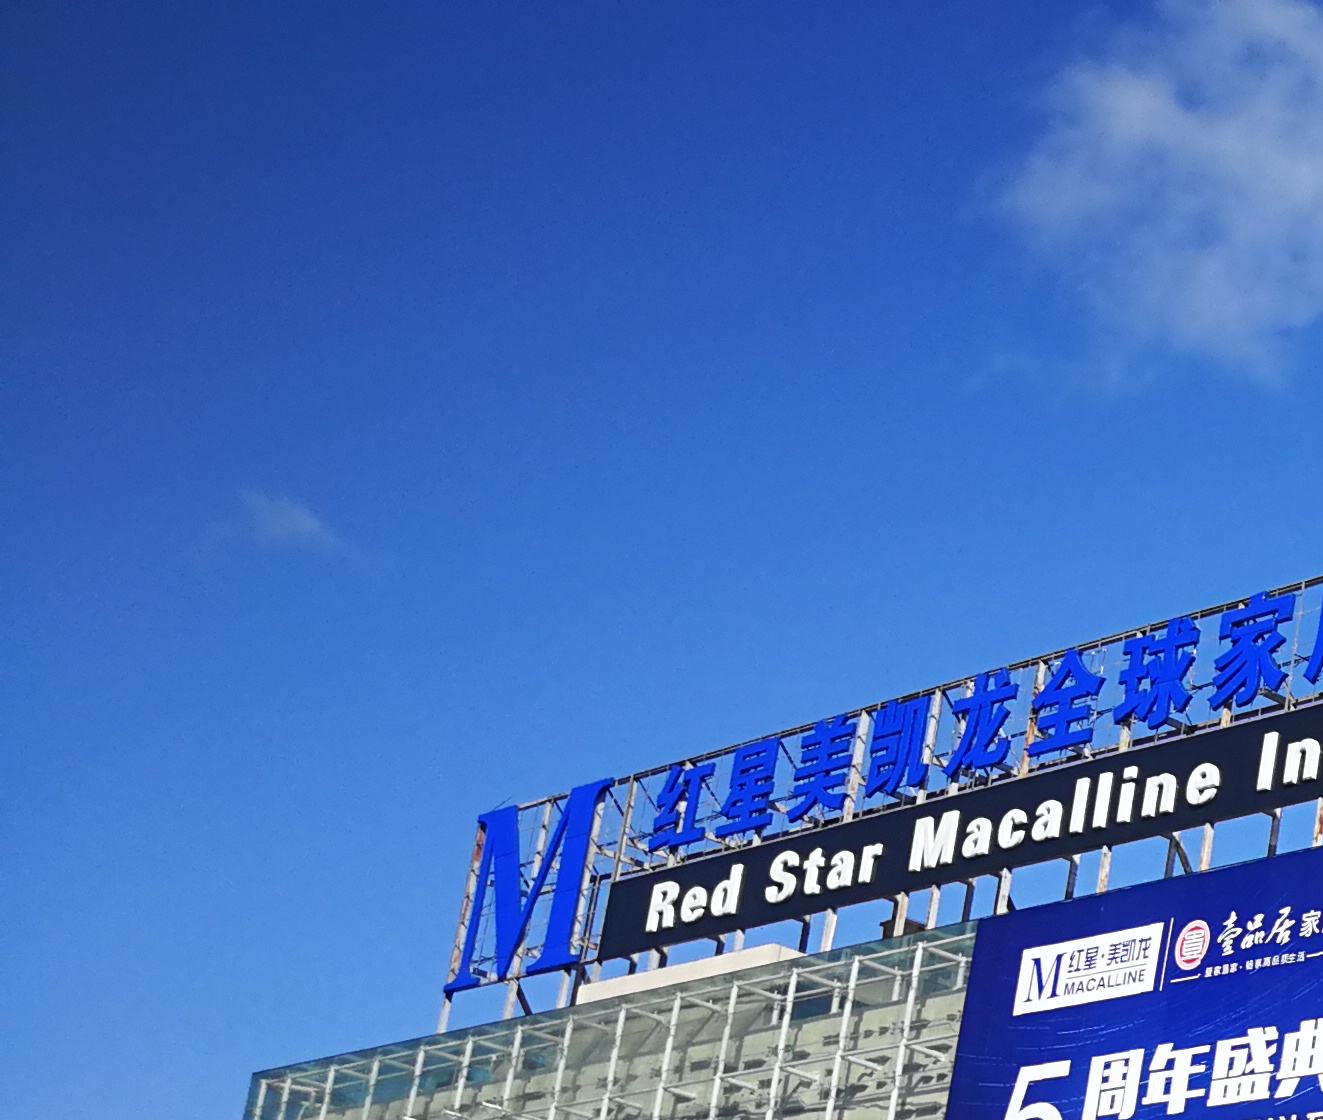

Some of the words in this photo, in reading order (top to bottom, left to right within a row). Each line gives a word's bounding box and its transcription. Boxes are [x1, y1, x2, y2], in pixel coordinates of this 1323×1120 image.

[444, 778, 612, 994] M
[645, 863, 743, 933] Red
[765, 840, 884, 924] Star
[908, 762, 1221, 873] Macalline
[1024, 950, 1066, 1003] M
[1063, 968, 1146, 996] MACALLINE
